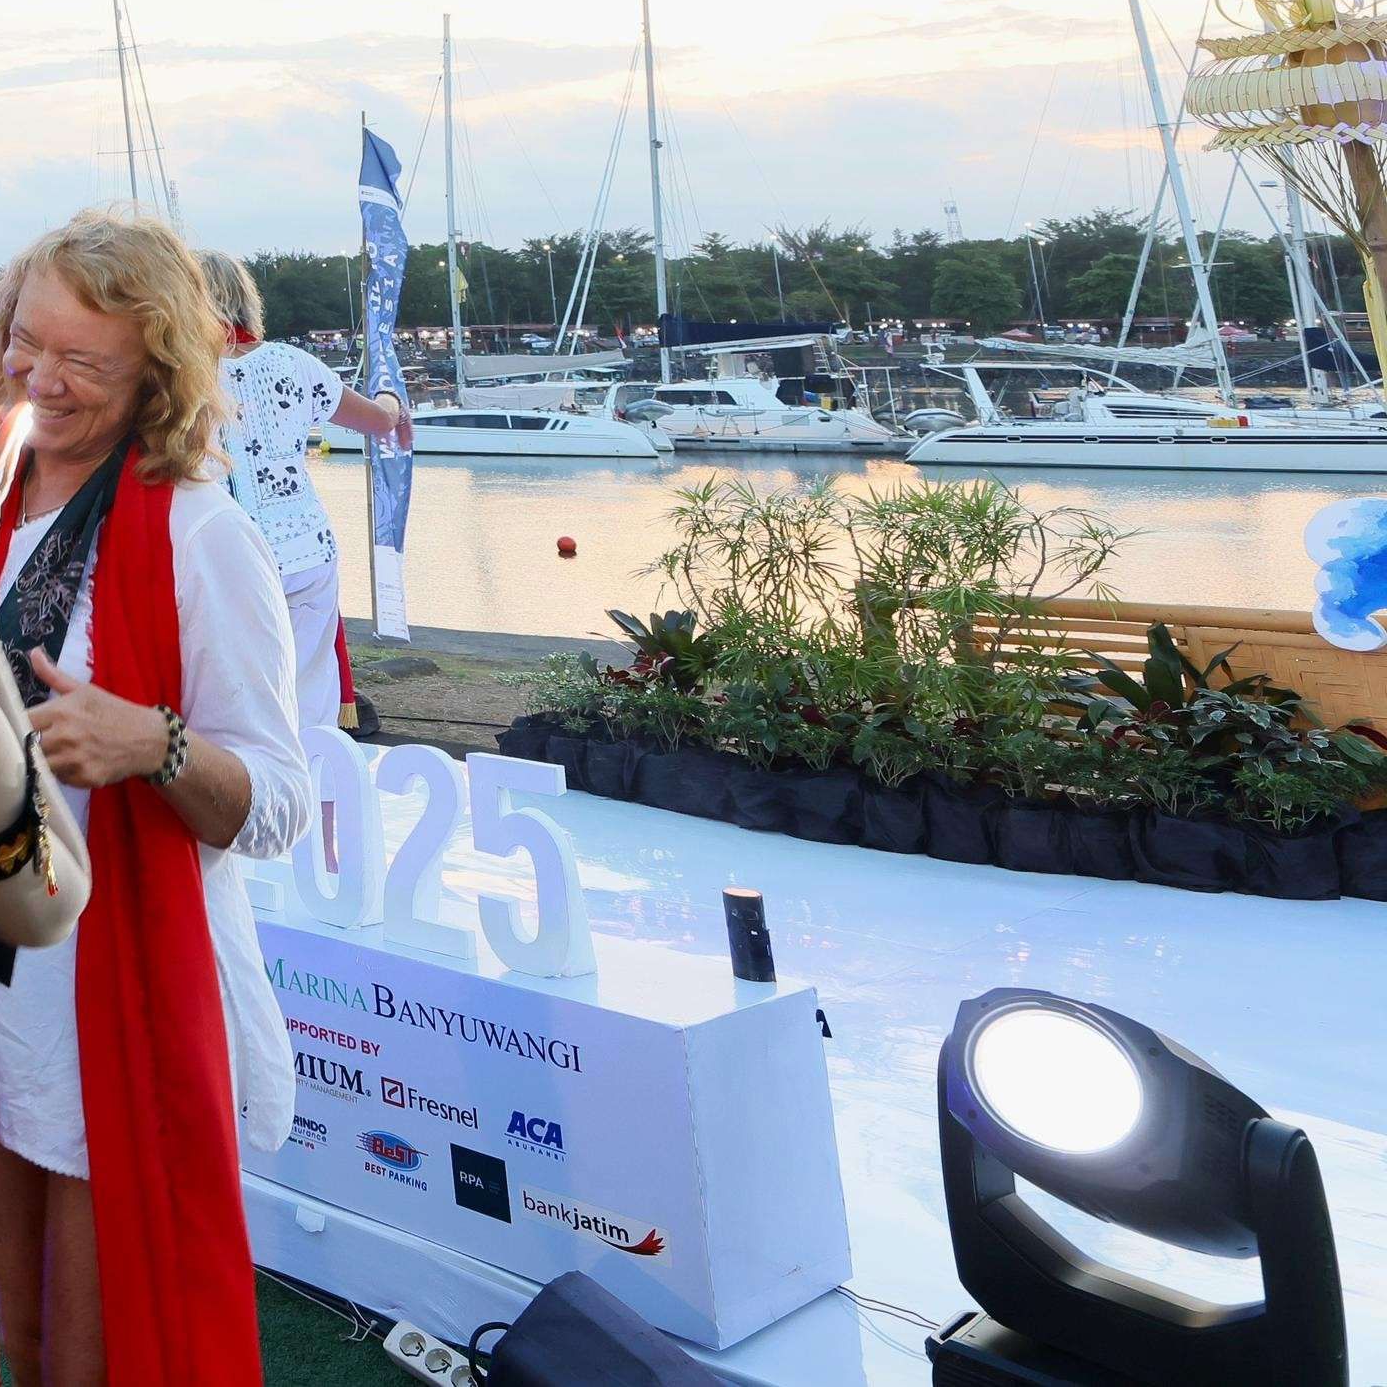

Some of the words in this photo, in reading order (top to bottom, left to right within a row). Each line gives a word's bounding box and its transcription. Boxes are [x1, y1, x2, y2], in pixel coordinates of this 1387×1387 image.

[264, 958, 369, 1013] MARINA
[371, 982, 583, 1073] BANYUWANGI
[361, 1040, 381, 1057] BY
[310, 1082, 359, 1104] MANAGEMENT
[407, 1087, 479, 1129] Fresnel
[293, 1114, 327, 1135] RINDO
[506, 1110, 564, 1150] ACA
[364, 1161, 387, 1178] BEST
[388, 1169, 428, 1192] PARKING
[459, 1170, 485, 1190] RPA
[522, 1190, 630, 1244] bankjatim
